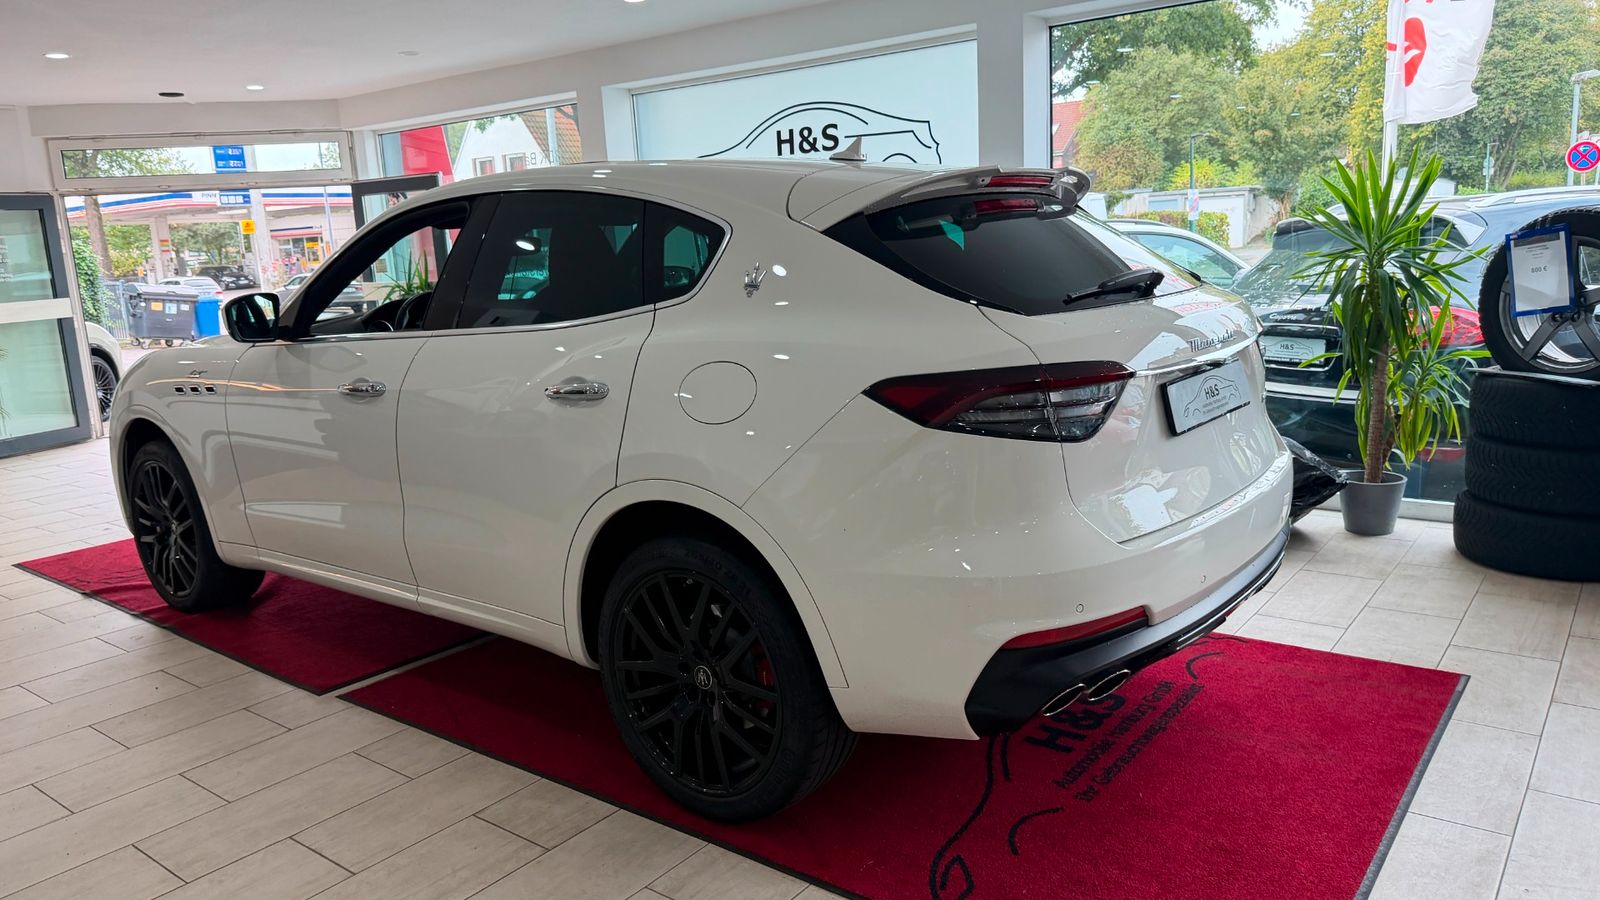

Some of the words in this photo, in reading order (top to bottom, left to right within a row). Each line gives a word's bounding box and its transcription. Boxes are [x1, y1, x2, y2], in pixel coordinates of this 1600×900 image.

[776, 123, 840, 156] H&S
[1187, 329, 1236, 352] Maserati
[1280, 343, 1295, 351] H&S
[1204, 383, 1220, 400] H&S
[1024, 693, 1126, 753] H&S
